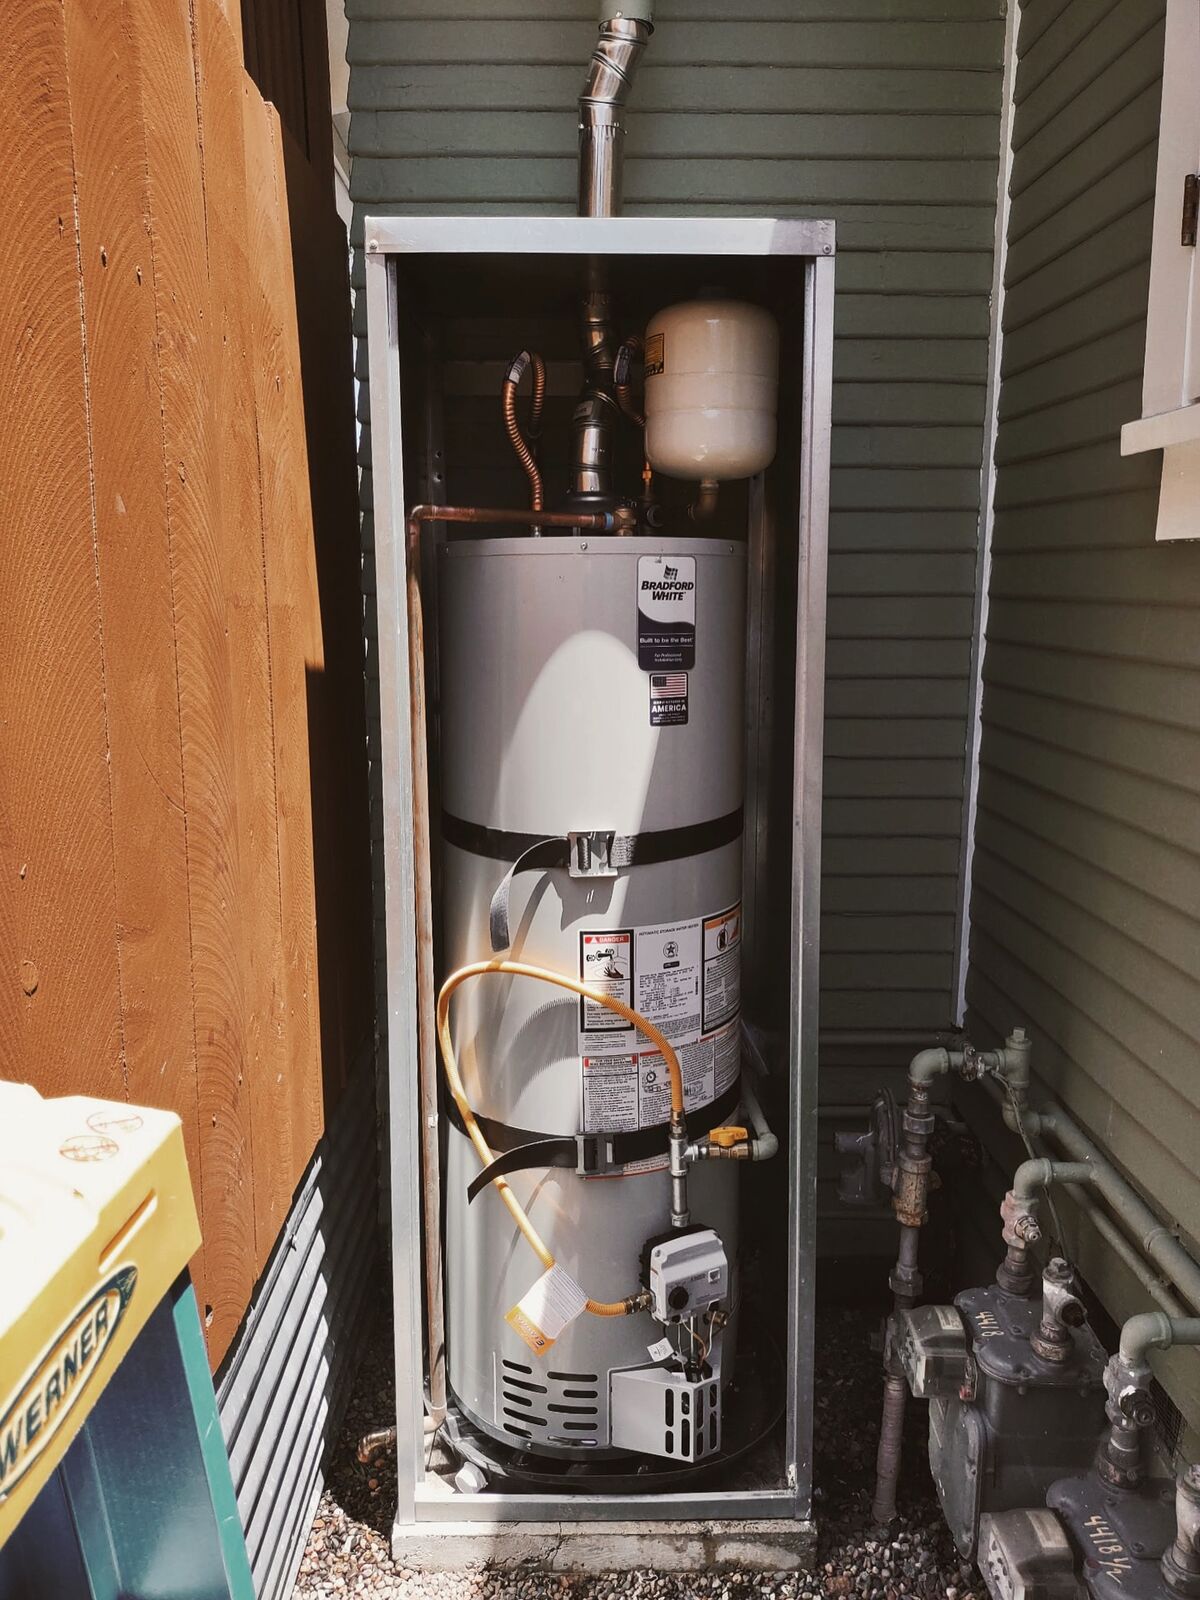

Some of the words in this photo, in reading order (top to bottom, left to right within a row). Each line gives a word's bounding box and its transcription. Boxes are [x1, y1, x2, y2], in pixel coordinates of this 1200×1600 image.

[641, 580, 694, 591] BRADFORD
[652, 591, 685, 601] WHITE
[651, 703, 687, 713] AMERICA
[975, 1311, 1004, 1337] 4418
[0, 1298, 109, 1480] WERNER
